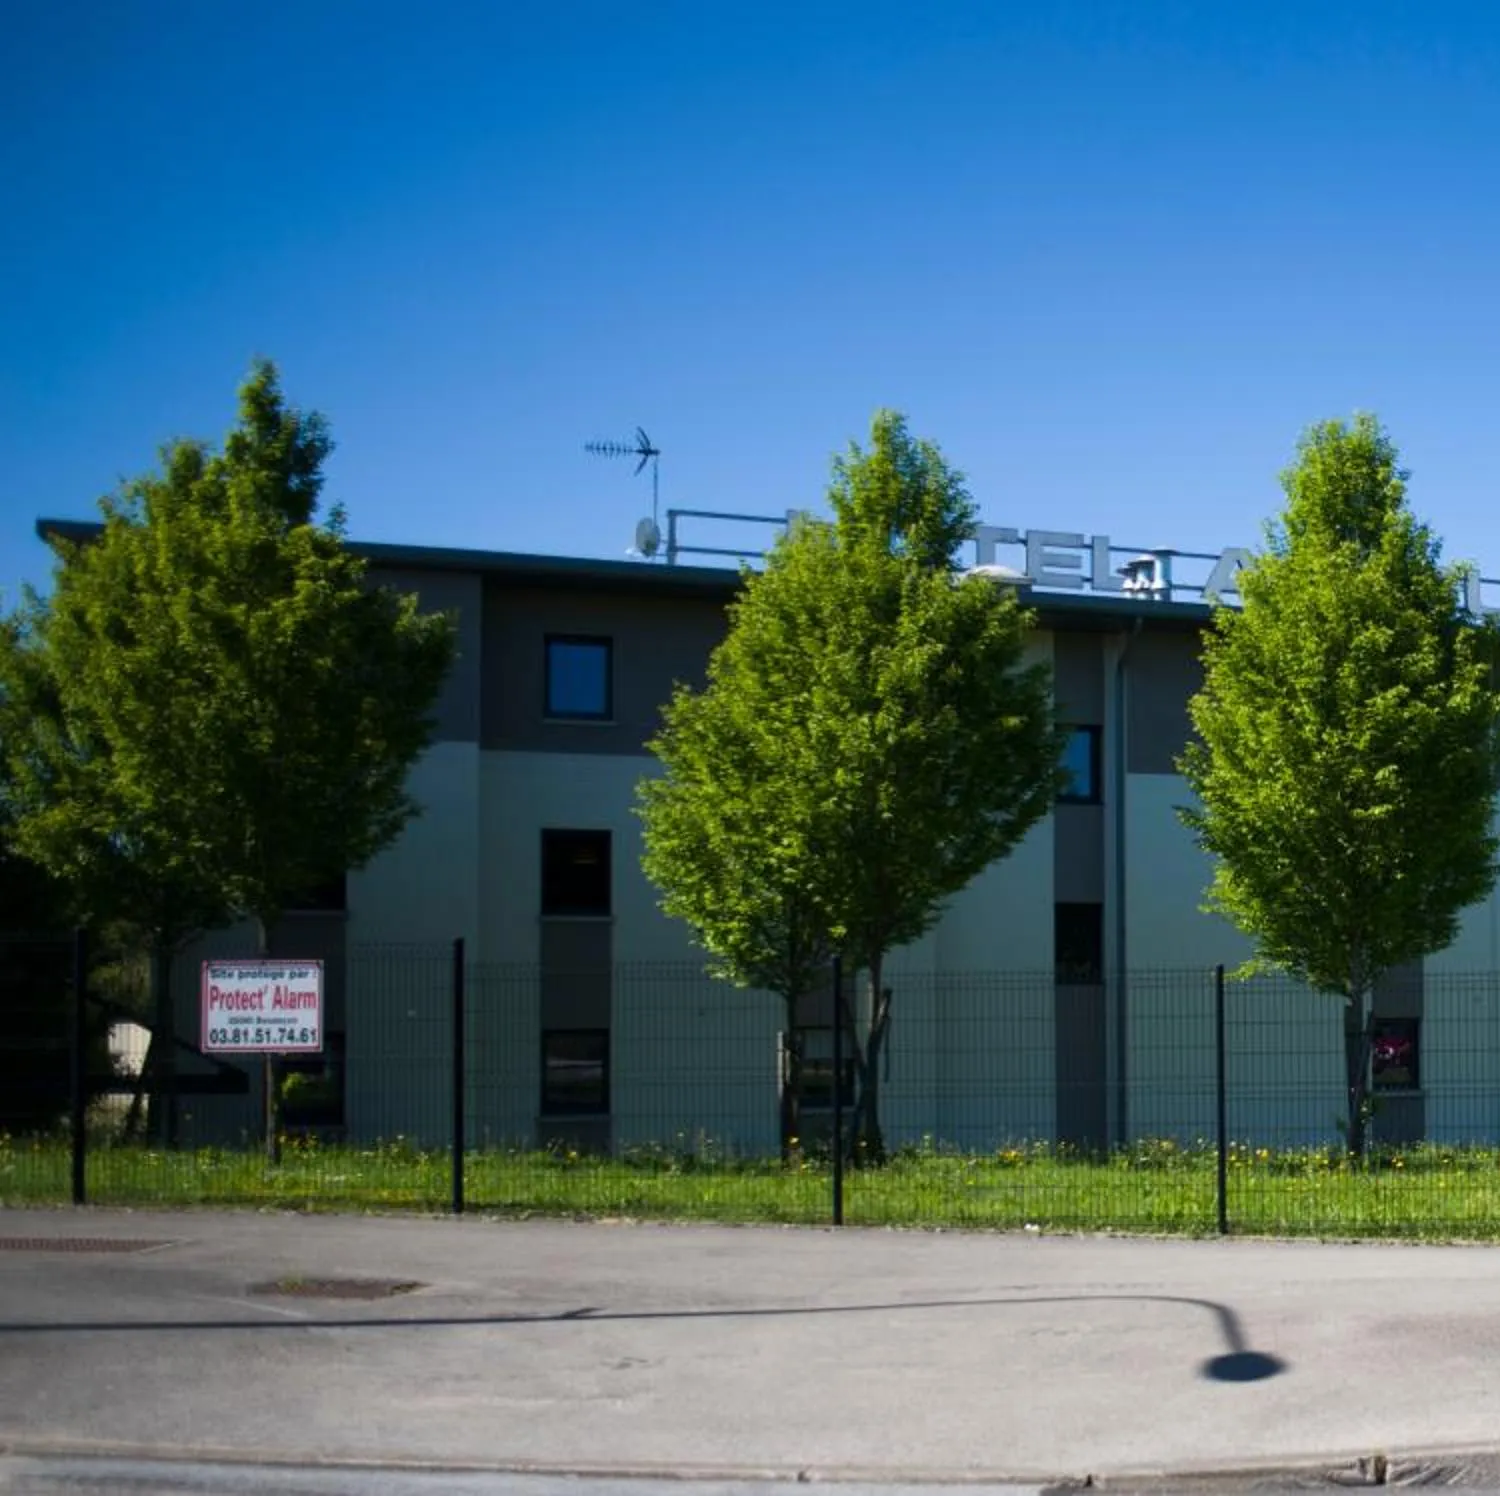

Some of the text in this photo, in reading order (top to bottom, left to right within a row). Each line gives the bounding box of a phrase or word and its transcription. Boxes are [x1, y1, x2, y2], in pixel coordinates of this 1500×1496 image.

[209, 984, 317, 1011] Protect' Alarm
[209, 1027, 317, 1045] 03.81.51.74.61
